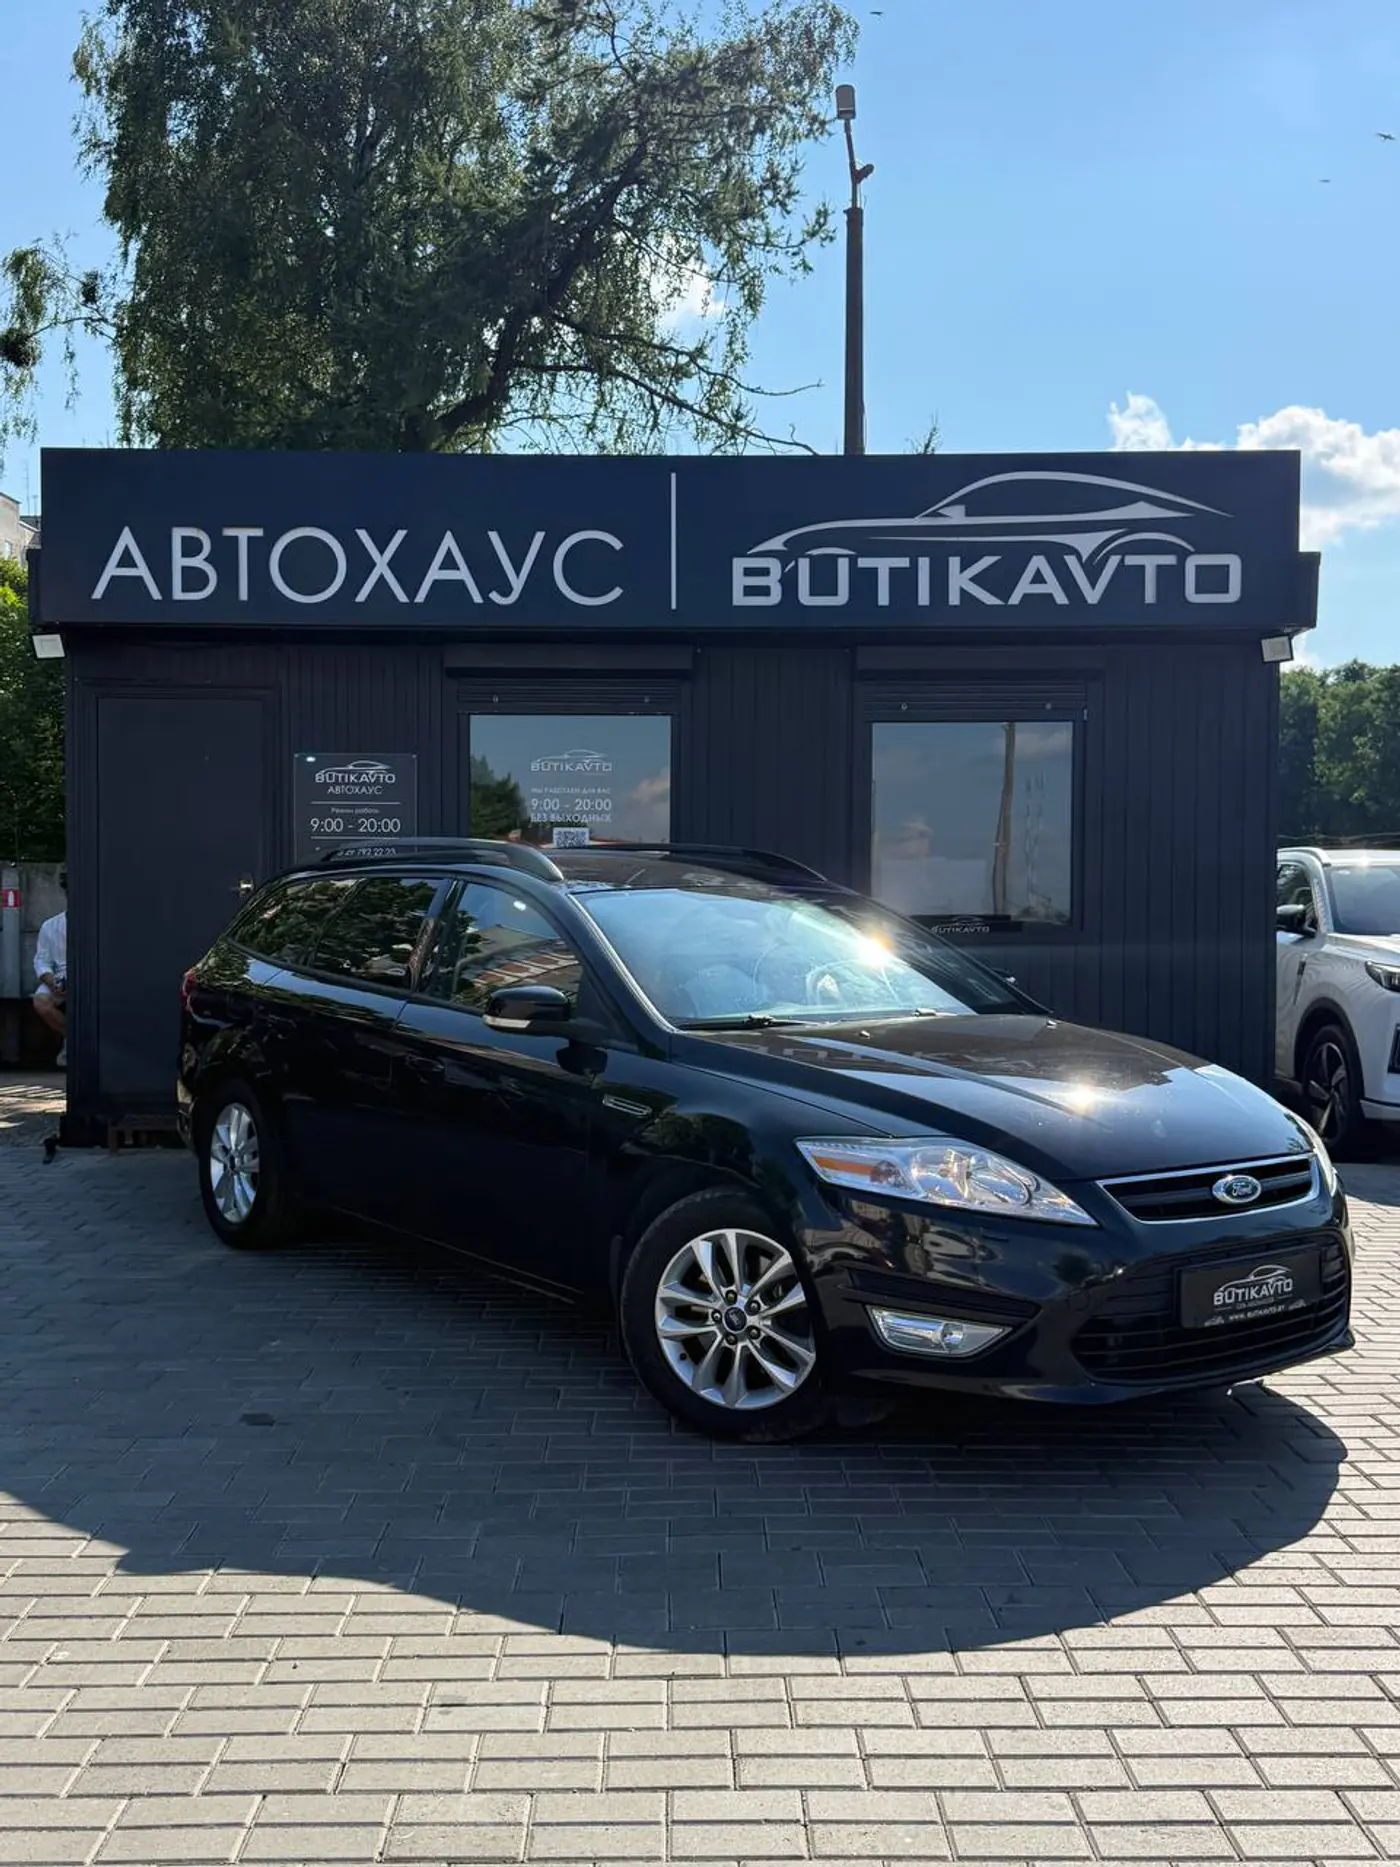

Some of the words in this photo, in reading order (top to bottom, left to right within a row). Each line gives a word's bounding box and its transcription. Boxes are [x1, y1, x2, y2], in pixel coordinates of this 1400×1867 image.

[91, 525, 624, 606] АВТОХАУС
[731, 547, 1242, 607] BUTIKAVTO
[531, 761, 612, 772] BUTIKAVTO
[315, 772, 396, 783] BUTIKAVTO
[327, 785, 382, 795] АВТОХАУС
[531, 798, 560, 811] 9:00
[575, 798, 612, 811] 20:00
[310, 818, 344, 832] 9:00
[358, 818, 401, 833] 20:00
[1213, 1278, 1293, 1306] BUTIKAVTO
